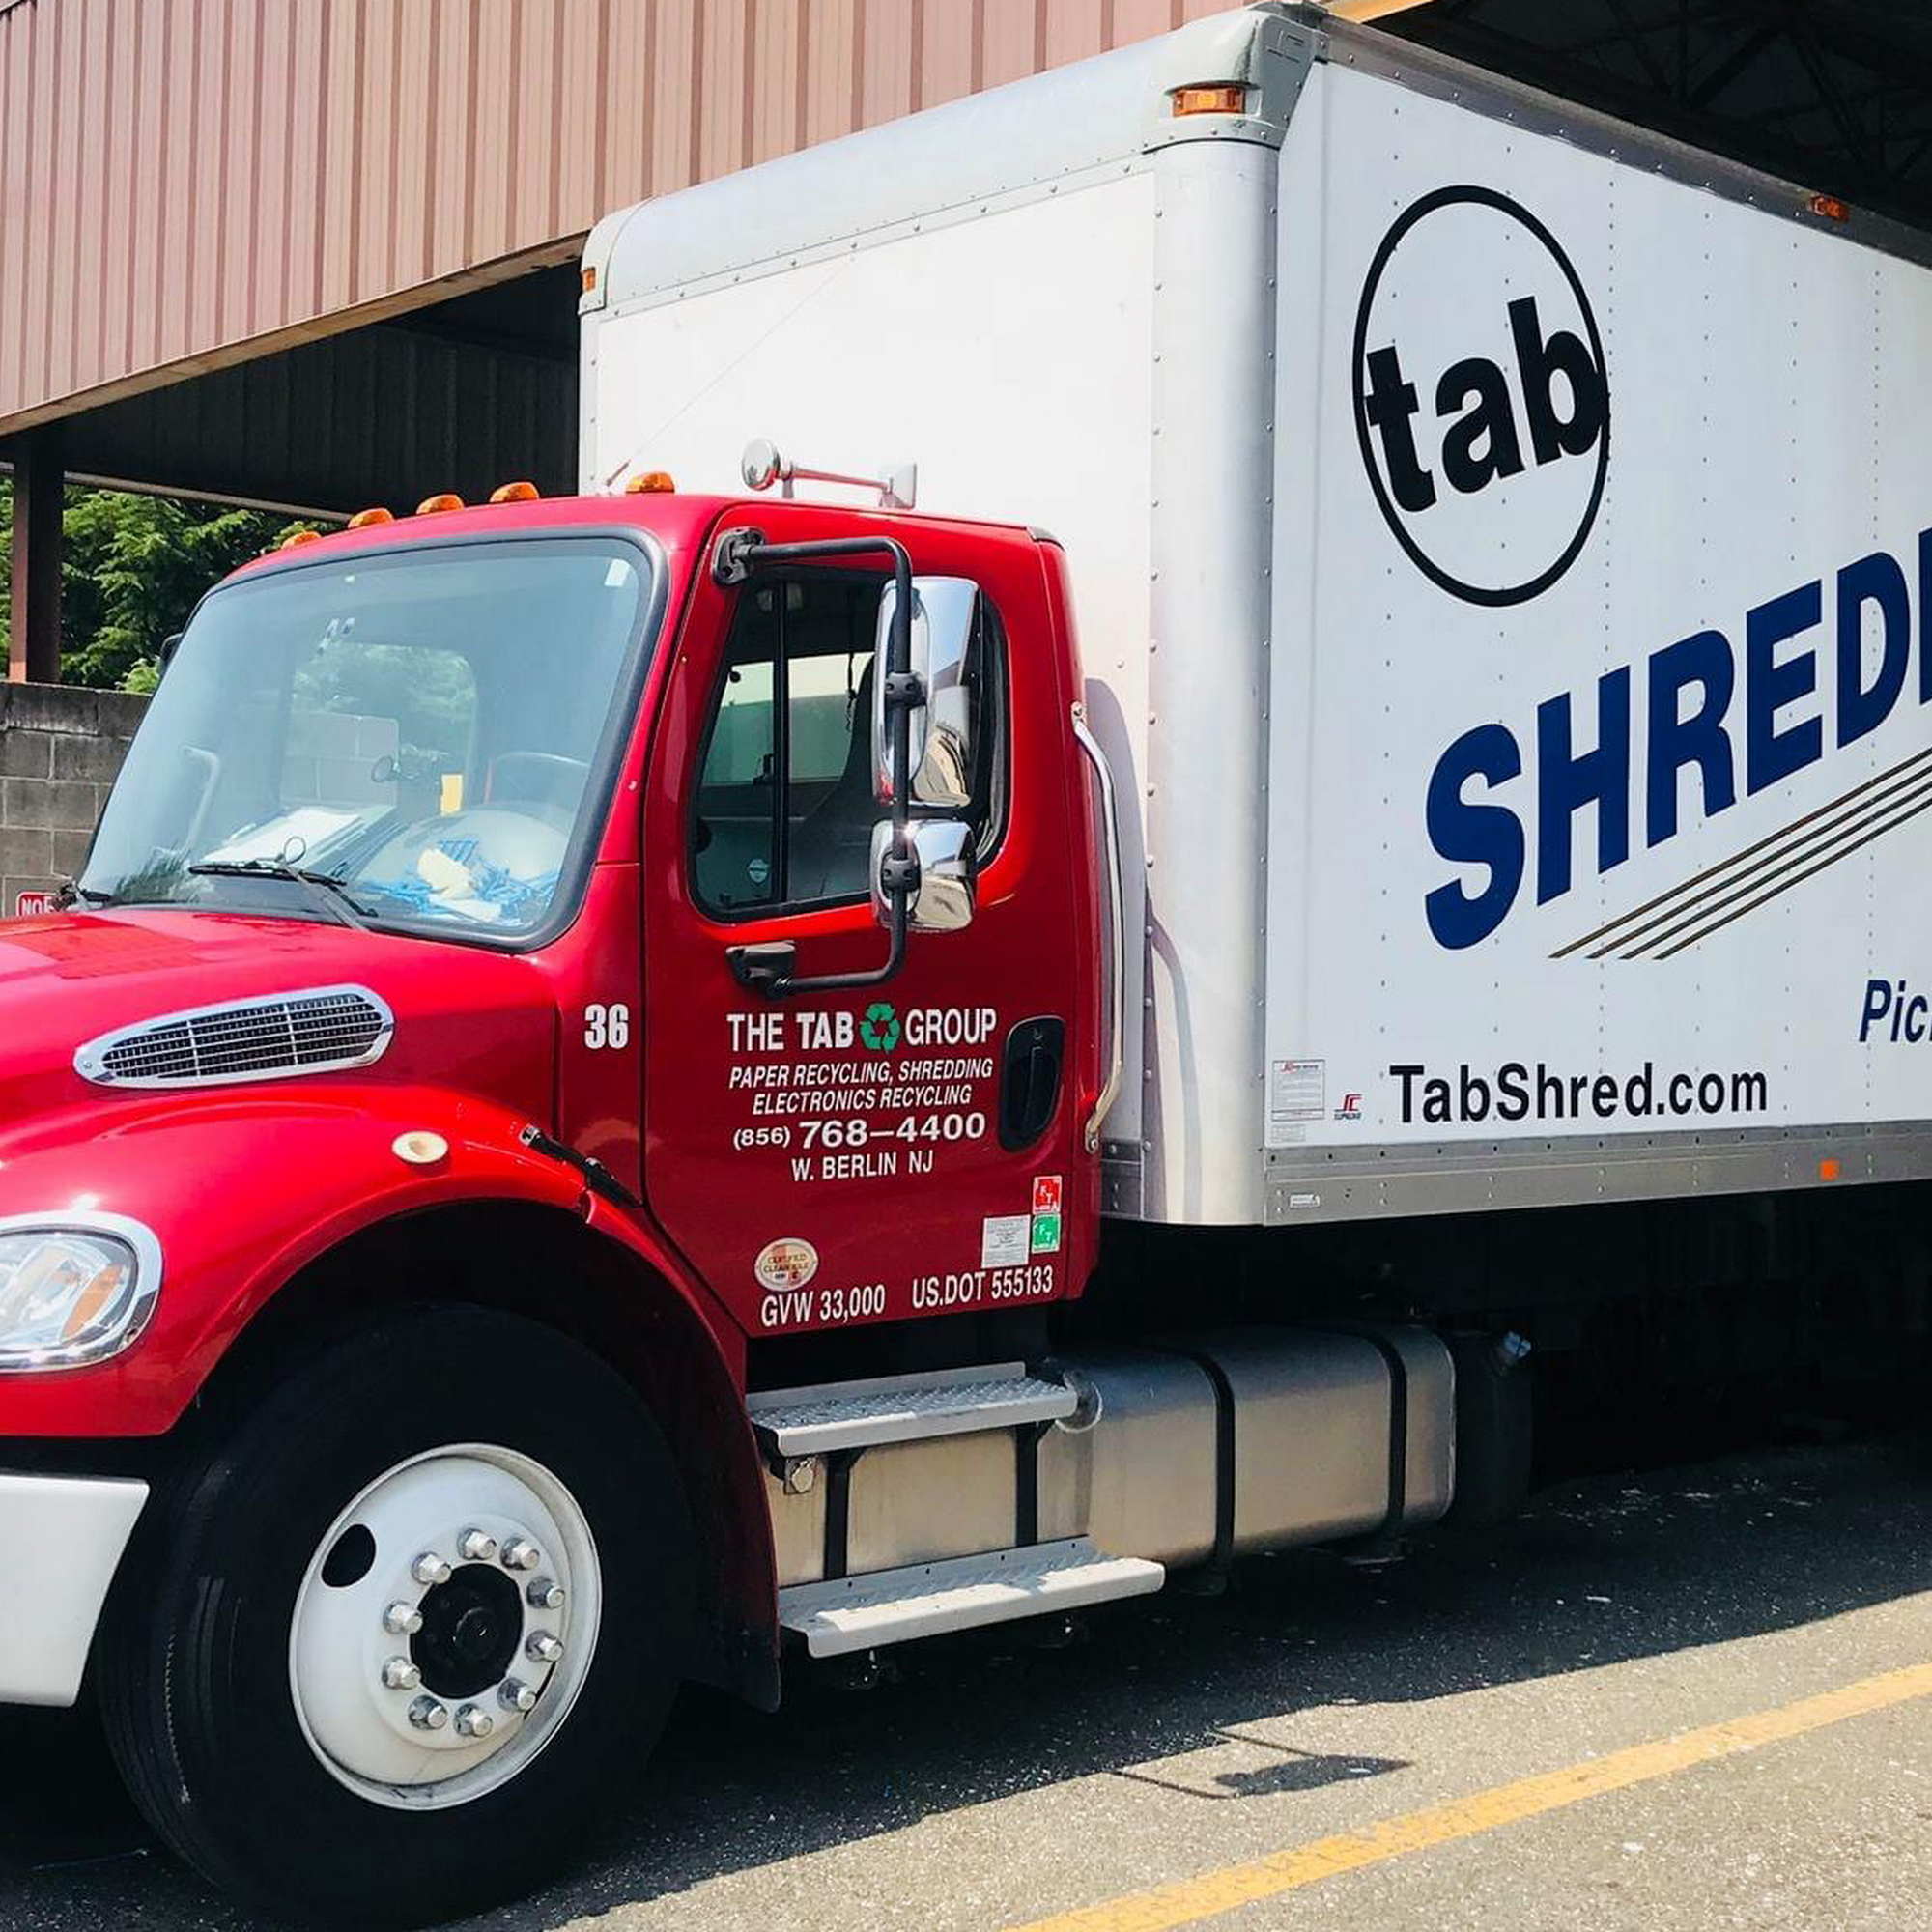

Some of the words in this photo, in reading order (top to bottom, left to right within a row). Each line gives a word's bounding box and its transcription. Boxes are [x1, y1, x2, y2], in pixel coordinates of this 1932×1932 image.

[1364, 296, 1609, 512] tab
[584, 1004, 629, 1049] 36
[726, 1013, 784, 1051] THE
[796, 1012, 854, 1049] TAB
[905, 1008, 997, 1046] GROUP
[1859, 980, 1932, 1043] Pic
[729, 1066, 788, 1089] PAPER
[793, 1061, 894, 1087] RECYCLING,
[898, 1058, 993, 1082] SHREDDING
[1390, 1063, 1767, 1123] TabShred.com
[753, 1089, 875, 1115] ELECTRONICS
[880, 1084, 972, 1109] RECYCLING
[733, 1126, 791, 1150] (856)
[799, 1112, 986, 1149] 768-4400
[791, 1158, 814, 1182] W.
[822, 1152, 897, 1179] BERLIN
[908, 1150, 934, 1173] NJ
[761, 1291, 813, 1326] GVW
[820, 1285, 886, 1322] 33,000
[912, 1272, 985, 1308] US.DOT
[991, 1265, 1053, 1299] 555133
